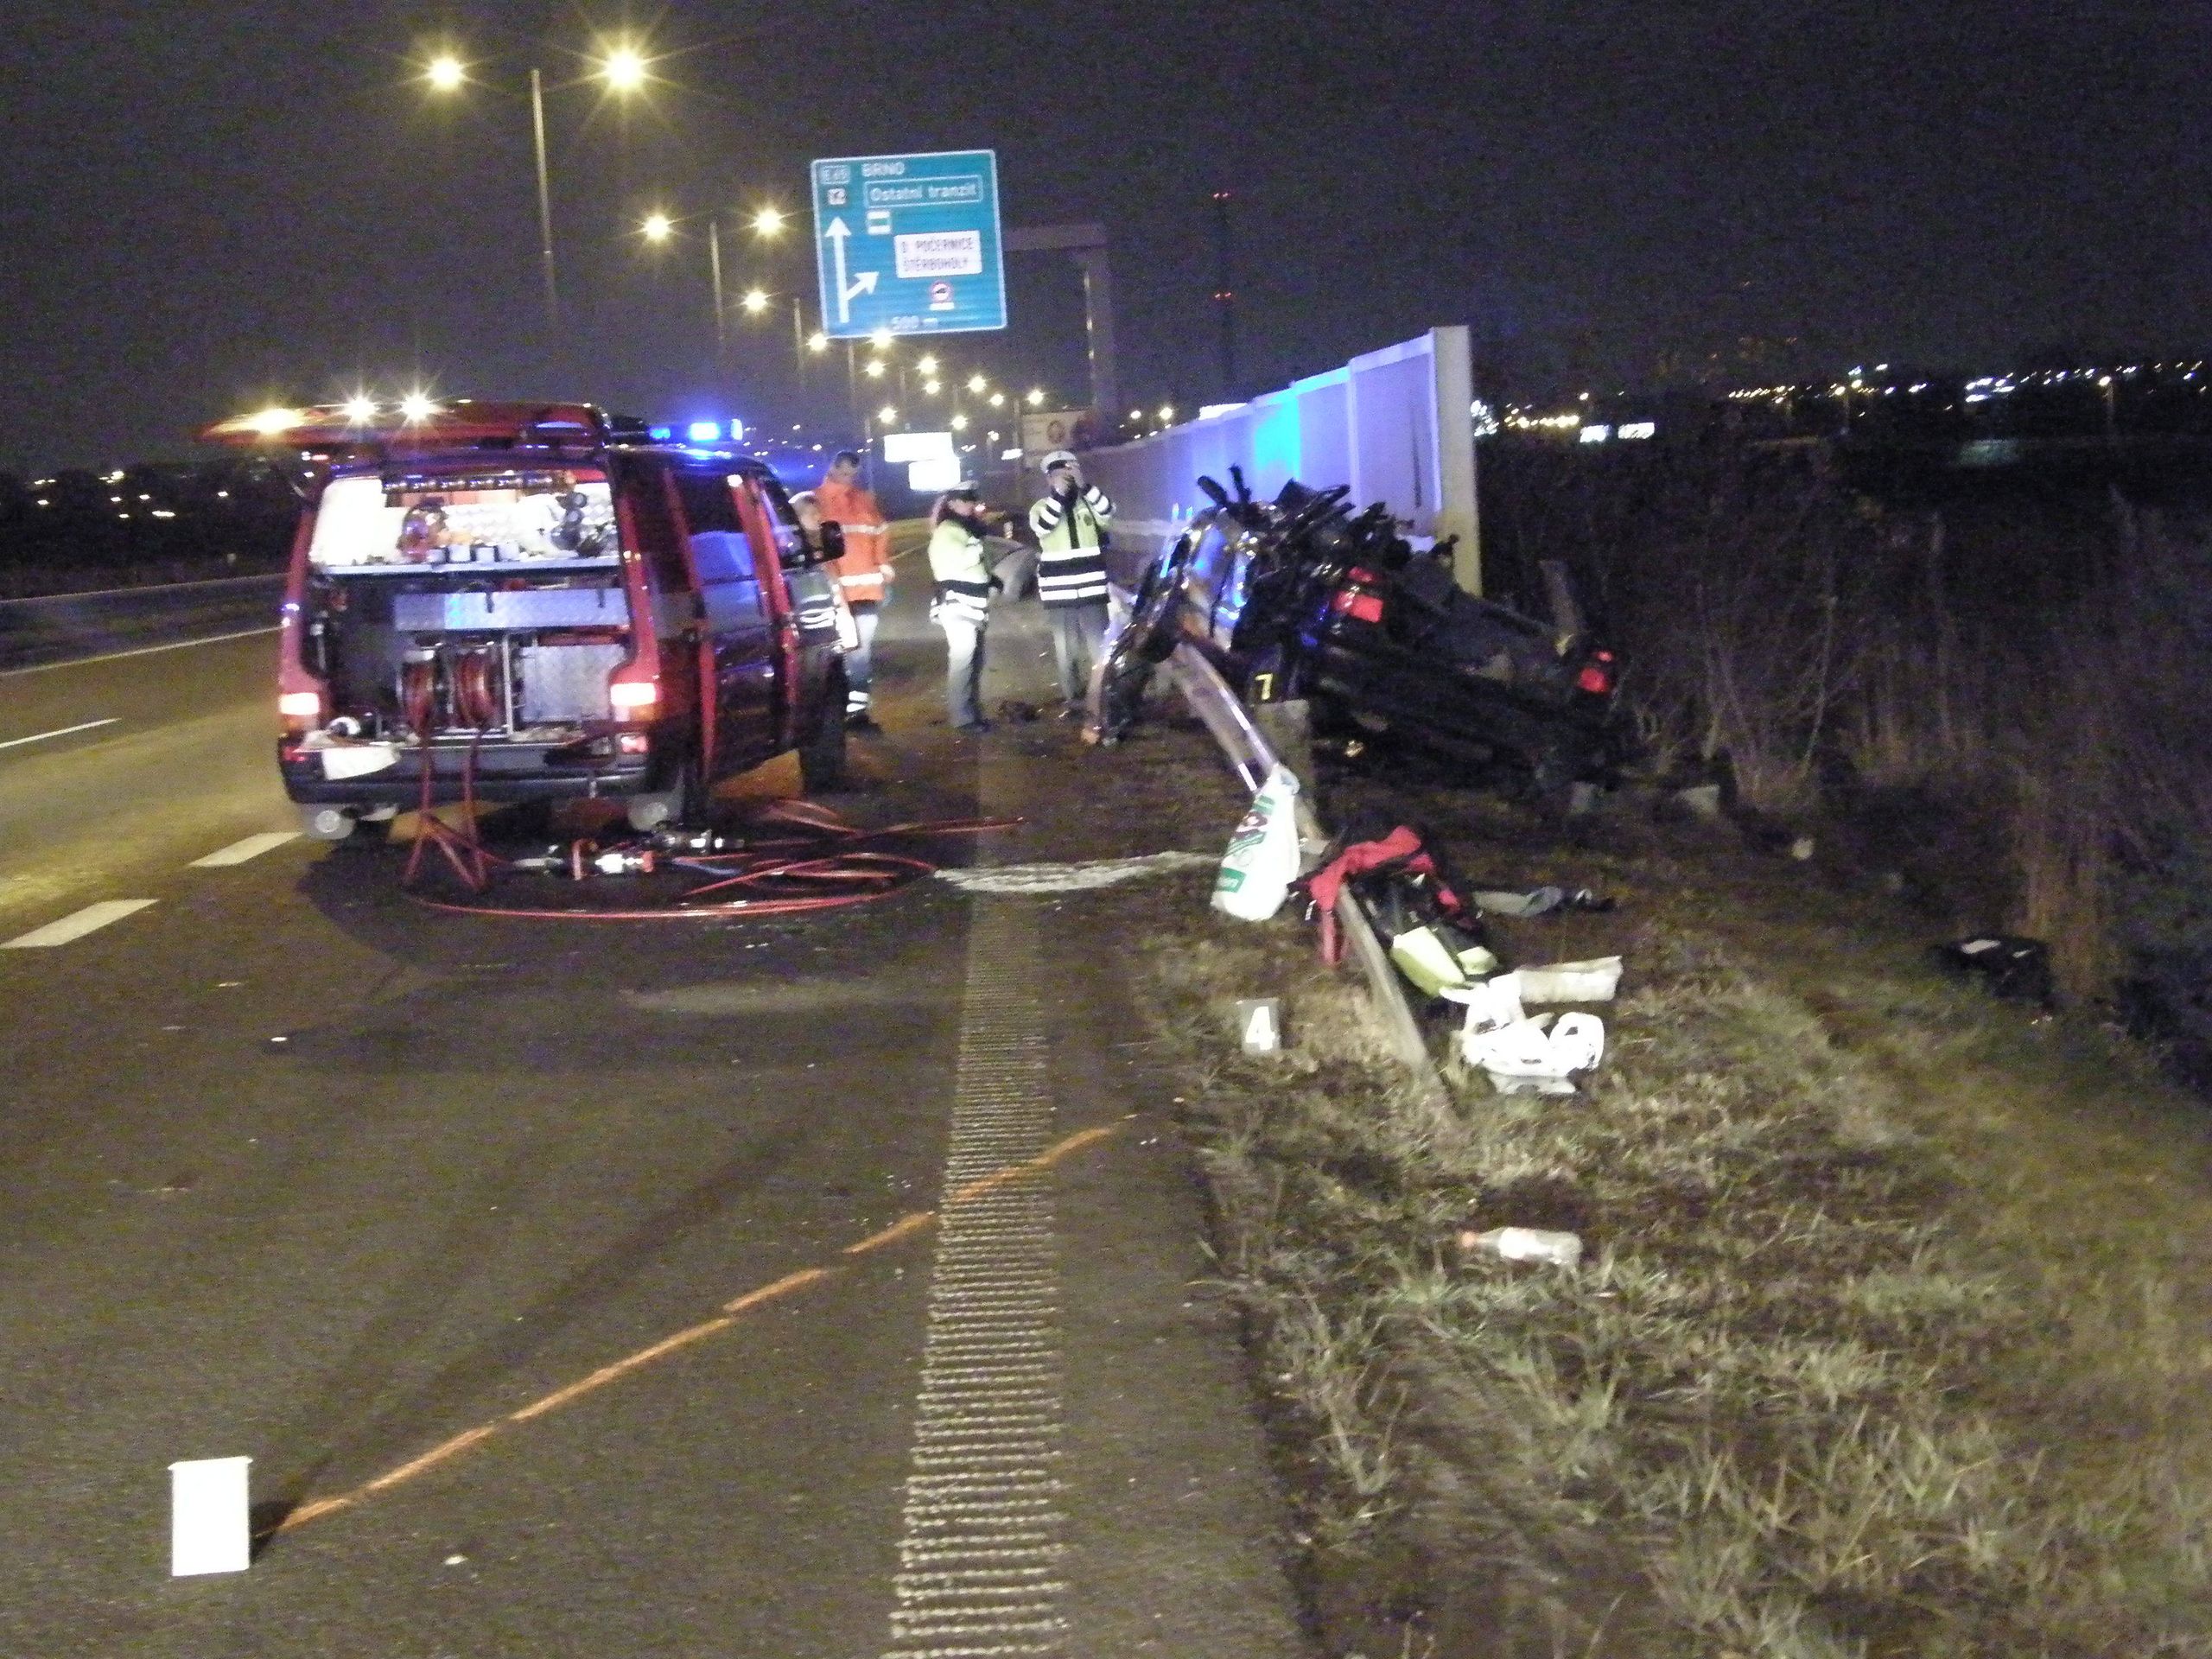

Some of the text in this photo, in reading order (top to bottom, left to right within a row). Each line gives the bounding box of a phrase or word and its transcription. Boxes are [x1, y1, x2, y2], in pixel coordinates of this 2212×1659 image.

[861, 161, 905, 177] BRNO
[1255, 673, 1273, 700] 7
[1245, 1006, 1275, 1051] 4
